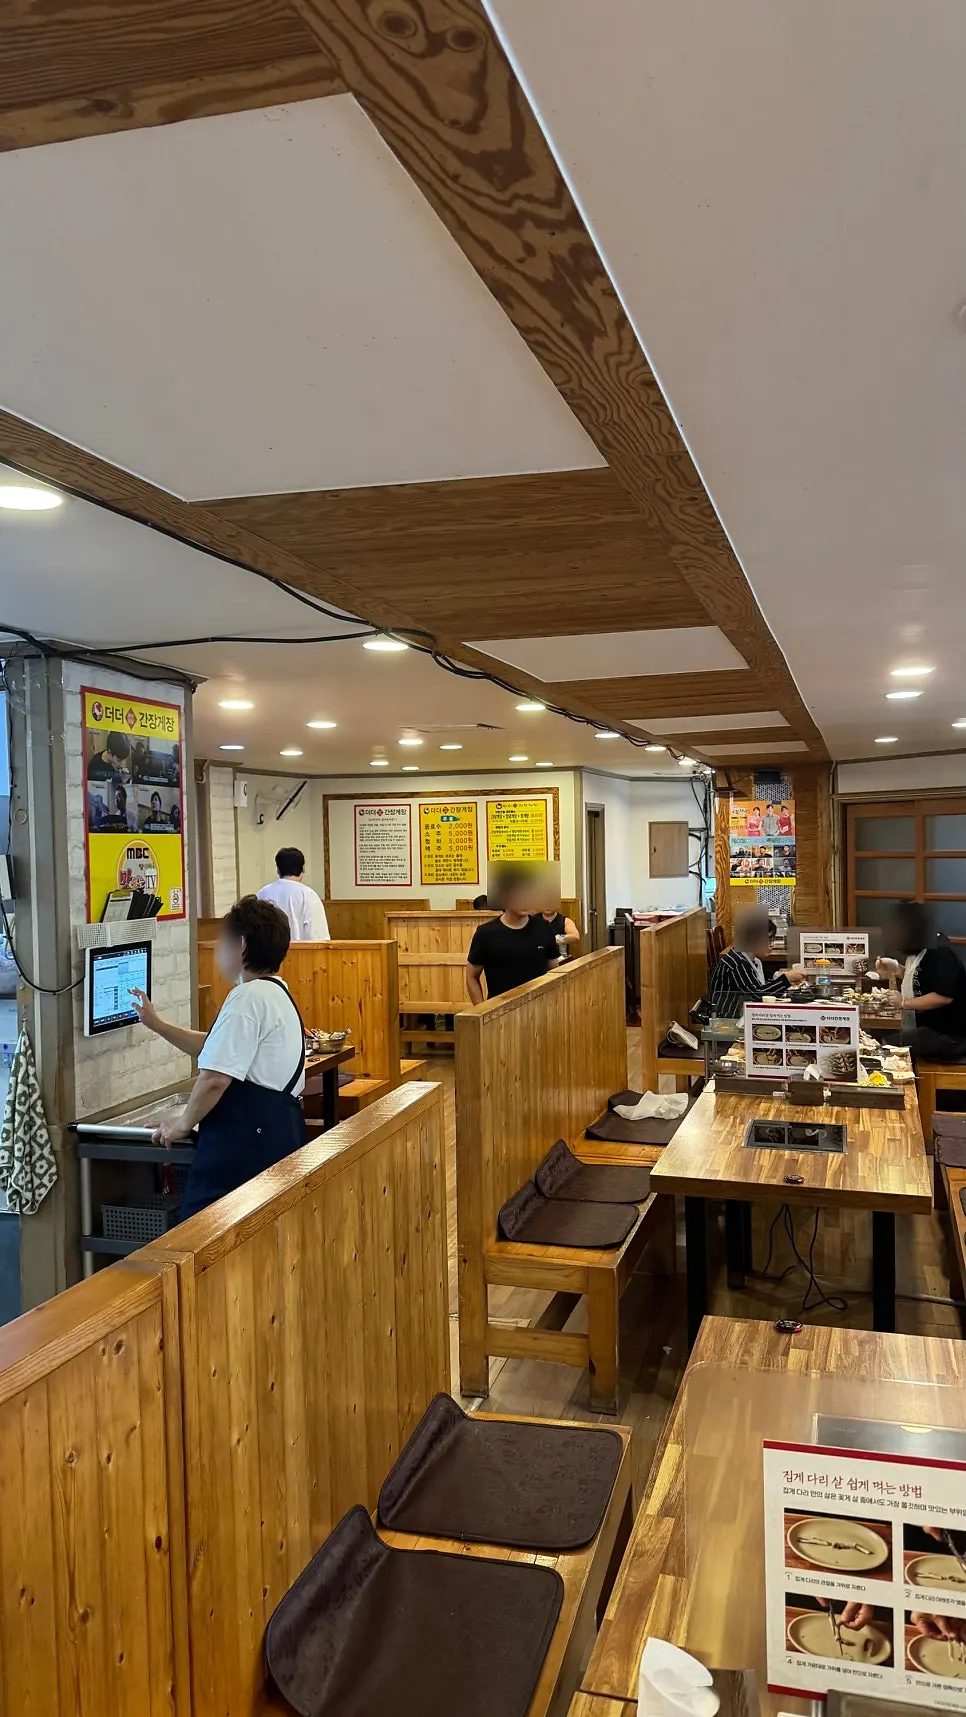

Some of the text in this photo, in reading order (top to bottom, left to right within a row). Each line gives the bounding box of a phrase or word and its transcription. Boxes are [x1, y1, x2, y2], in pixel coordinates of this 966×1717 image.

[105, 707, 124, 724] 더더
[139, 712, 174, 732] 간장게장
[127, 848, 149, 859] MBC
[783, 1470, 922, 1498] 집게 다리 살 쉽게 먹는 방법
[860, 1497, 885, 1506] 중에서도
[928, 1505, 948, 1514] 맛있는
